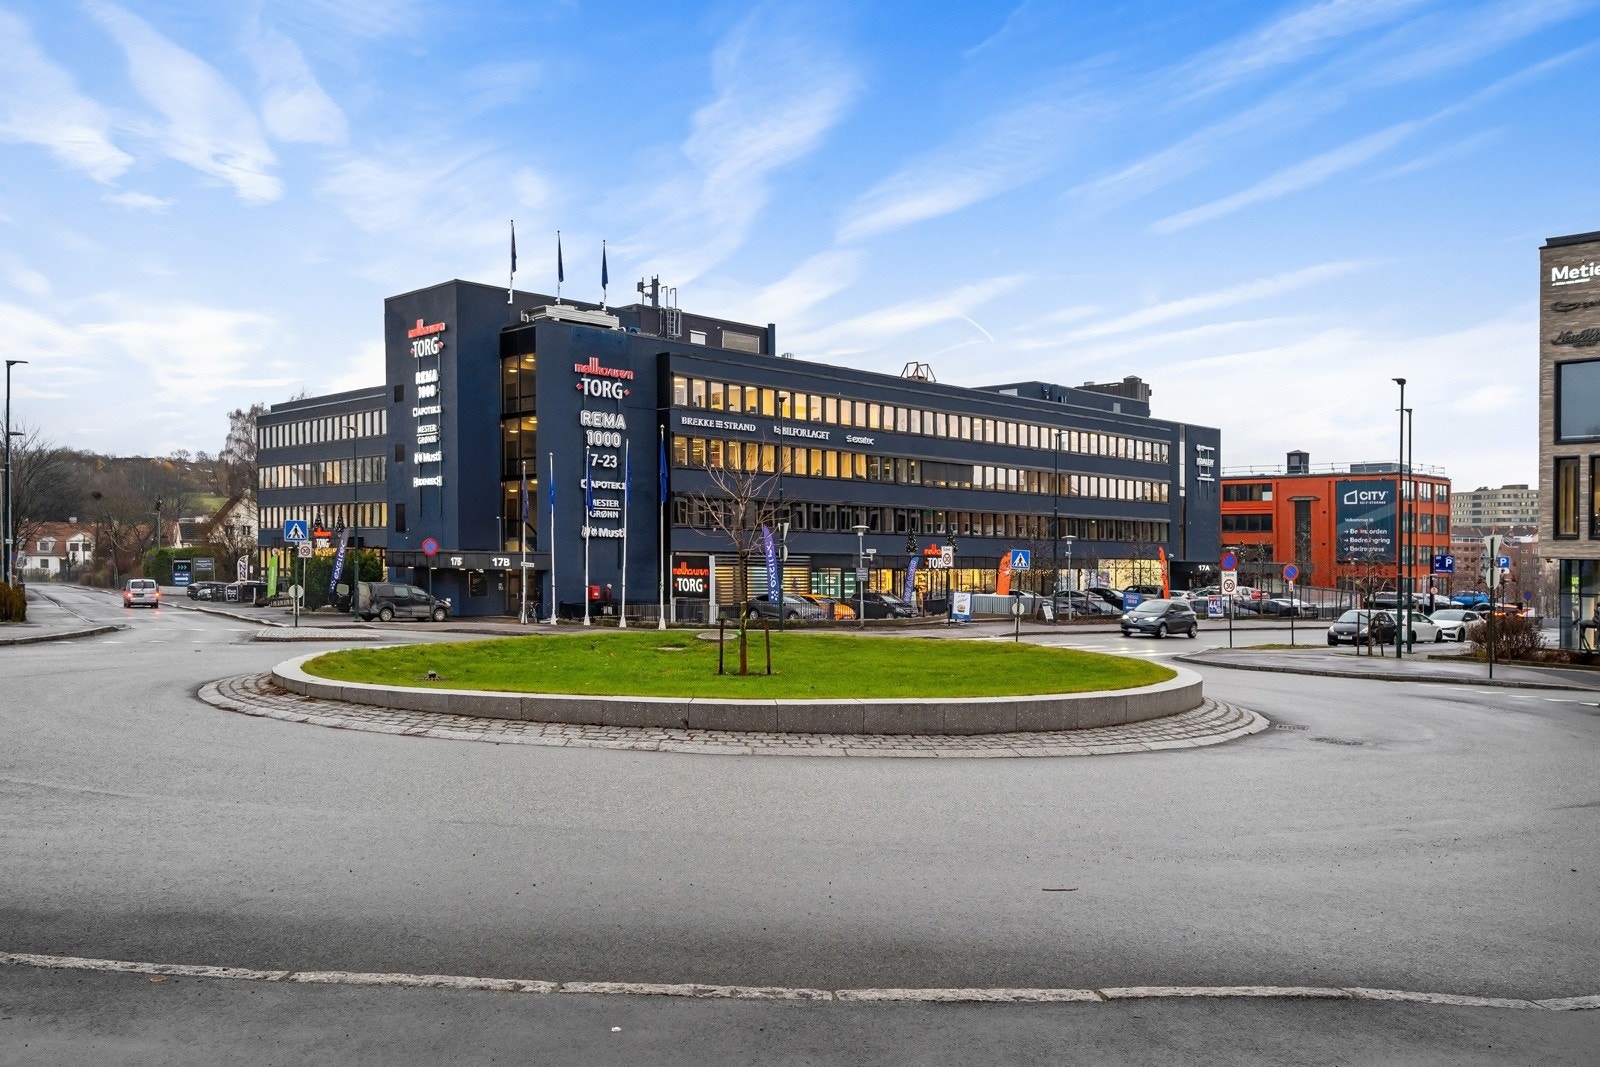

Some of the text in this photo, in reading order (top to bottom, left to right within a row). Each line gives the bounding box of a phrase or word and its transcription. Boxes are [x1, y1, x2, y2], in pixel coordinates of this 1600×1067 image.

[412, 337, 439, 358] TORG
[415, 369, 438, 385] REMA
[418, 384, 437, 399] 1000
[580, 378, 623, 400] TORG
[580, 410, 626, 430] REMA
[681, 416, 756, 432] BREKKE STRAND
[586, 430, 621, 448] 1000
[782, 426, 830, 440] BILFORLAGET
[590, 453, 618, 468] 7-23
[1359, 491, 1386, 500] CITY
[492, 557, 510, 567] 17B
[927, 557, 947, 568] TOR
[677, 577, 703, 592] TORG
